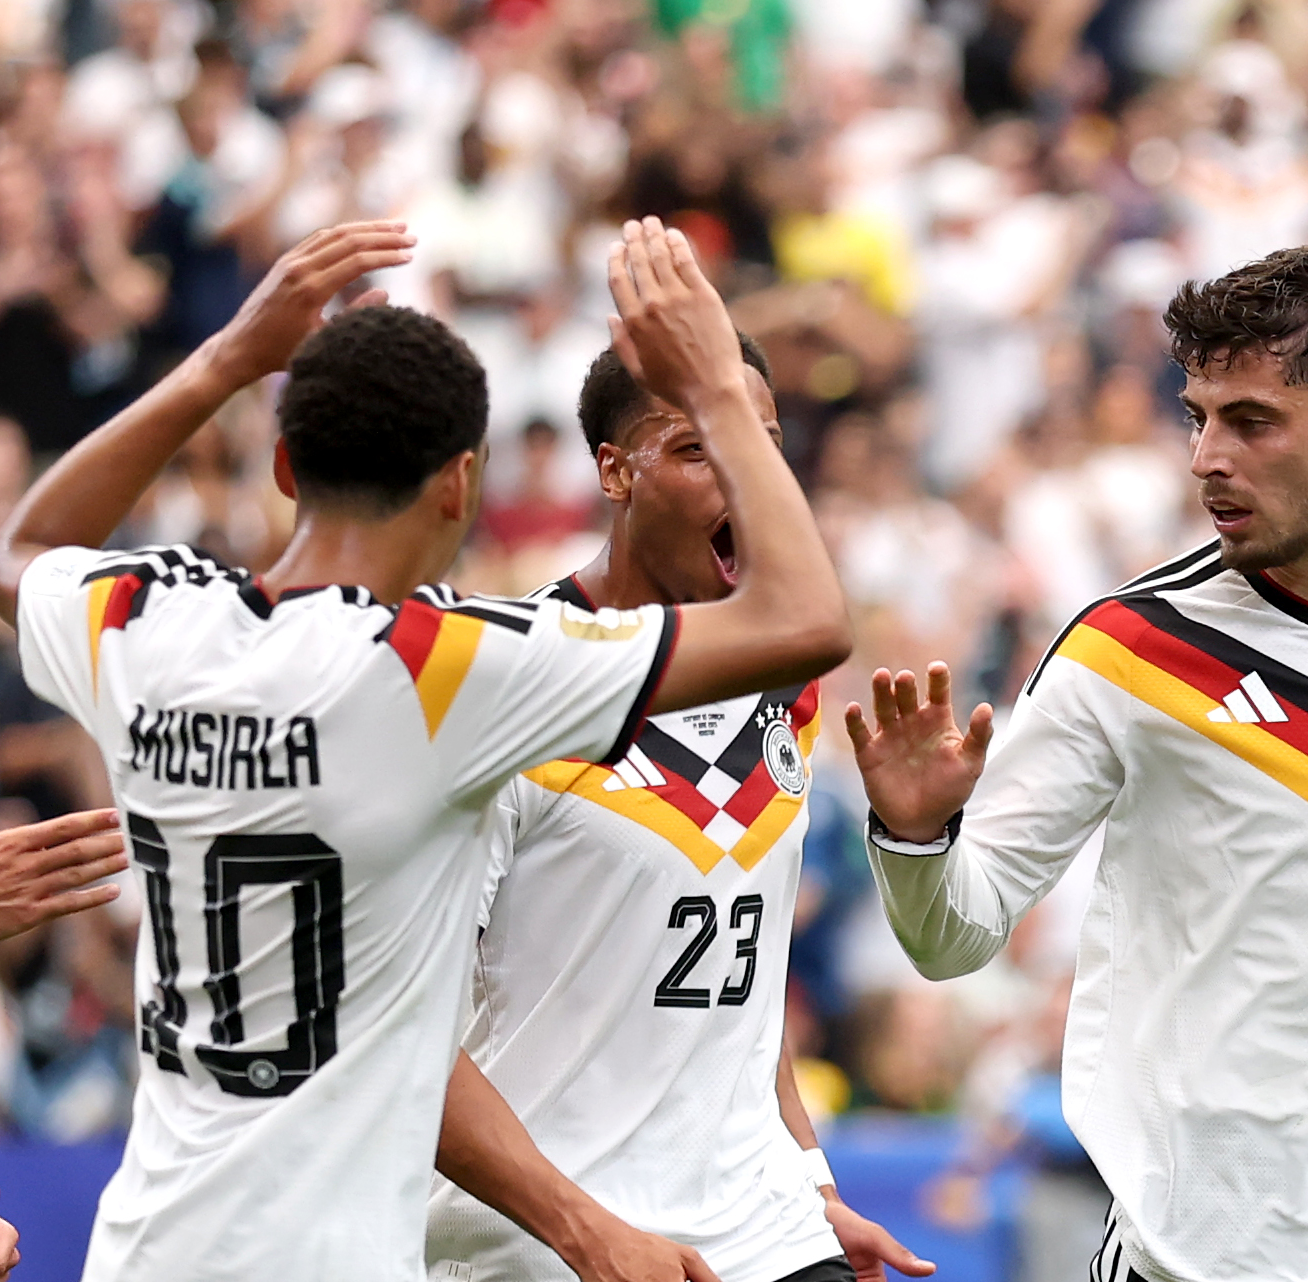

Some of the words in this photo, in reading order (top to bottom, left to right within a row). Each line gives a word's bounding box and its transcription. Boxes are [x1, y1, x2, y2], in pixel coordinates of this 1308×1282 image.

[129, 704, 321, 789] MUSIALA
[127, 811, 345, 1097] 10
[654, 894, 763, 1008] 23
